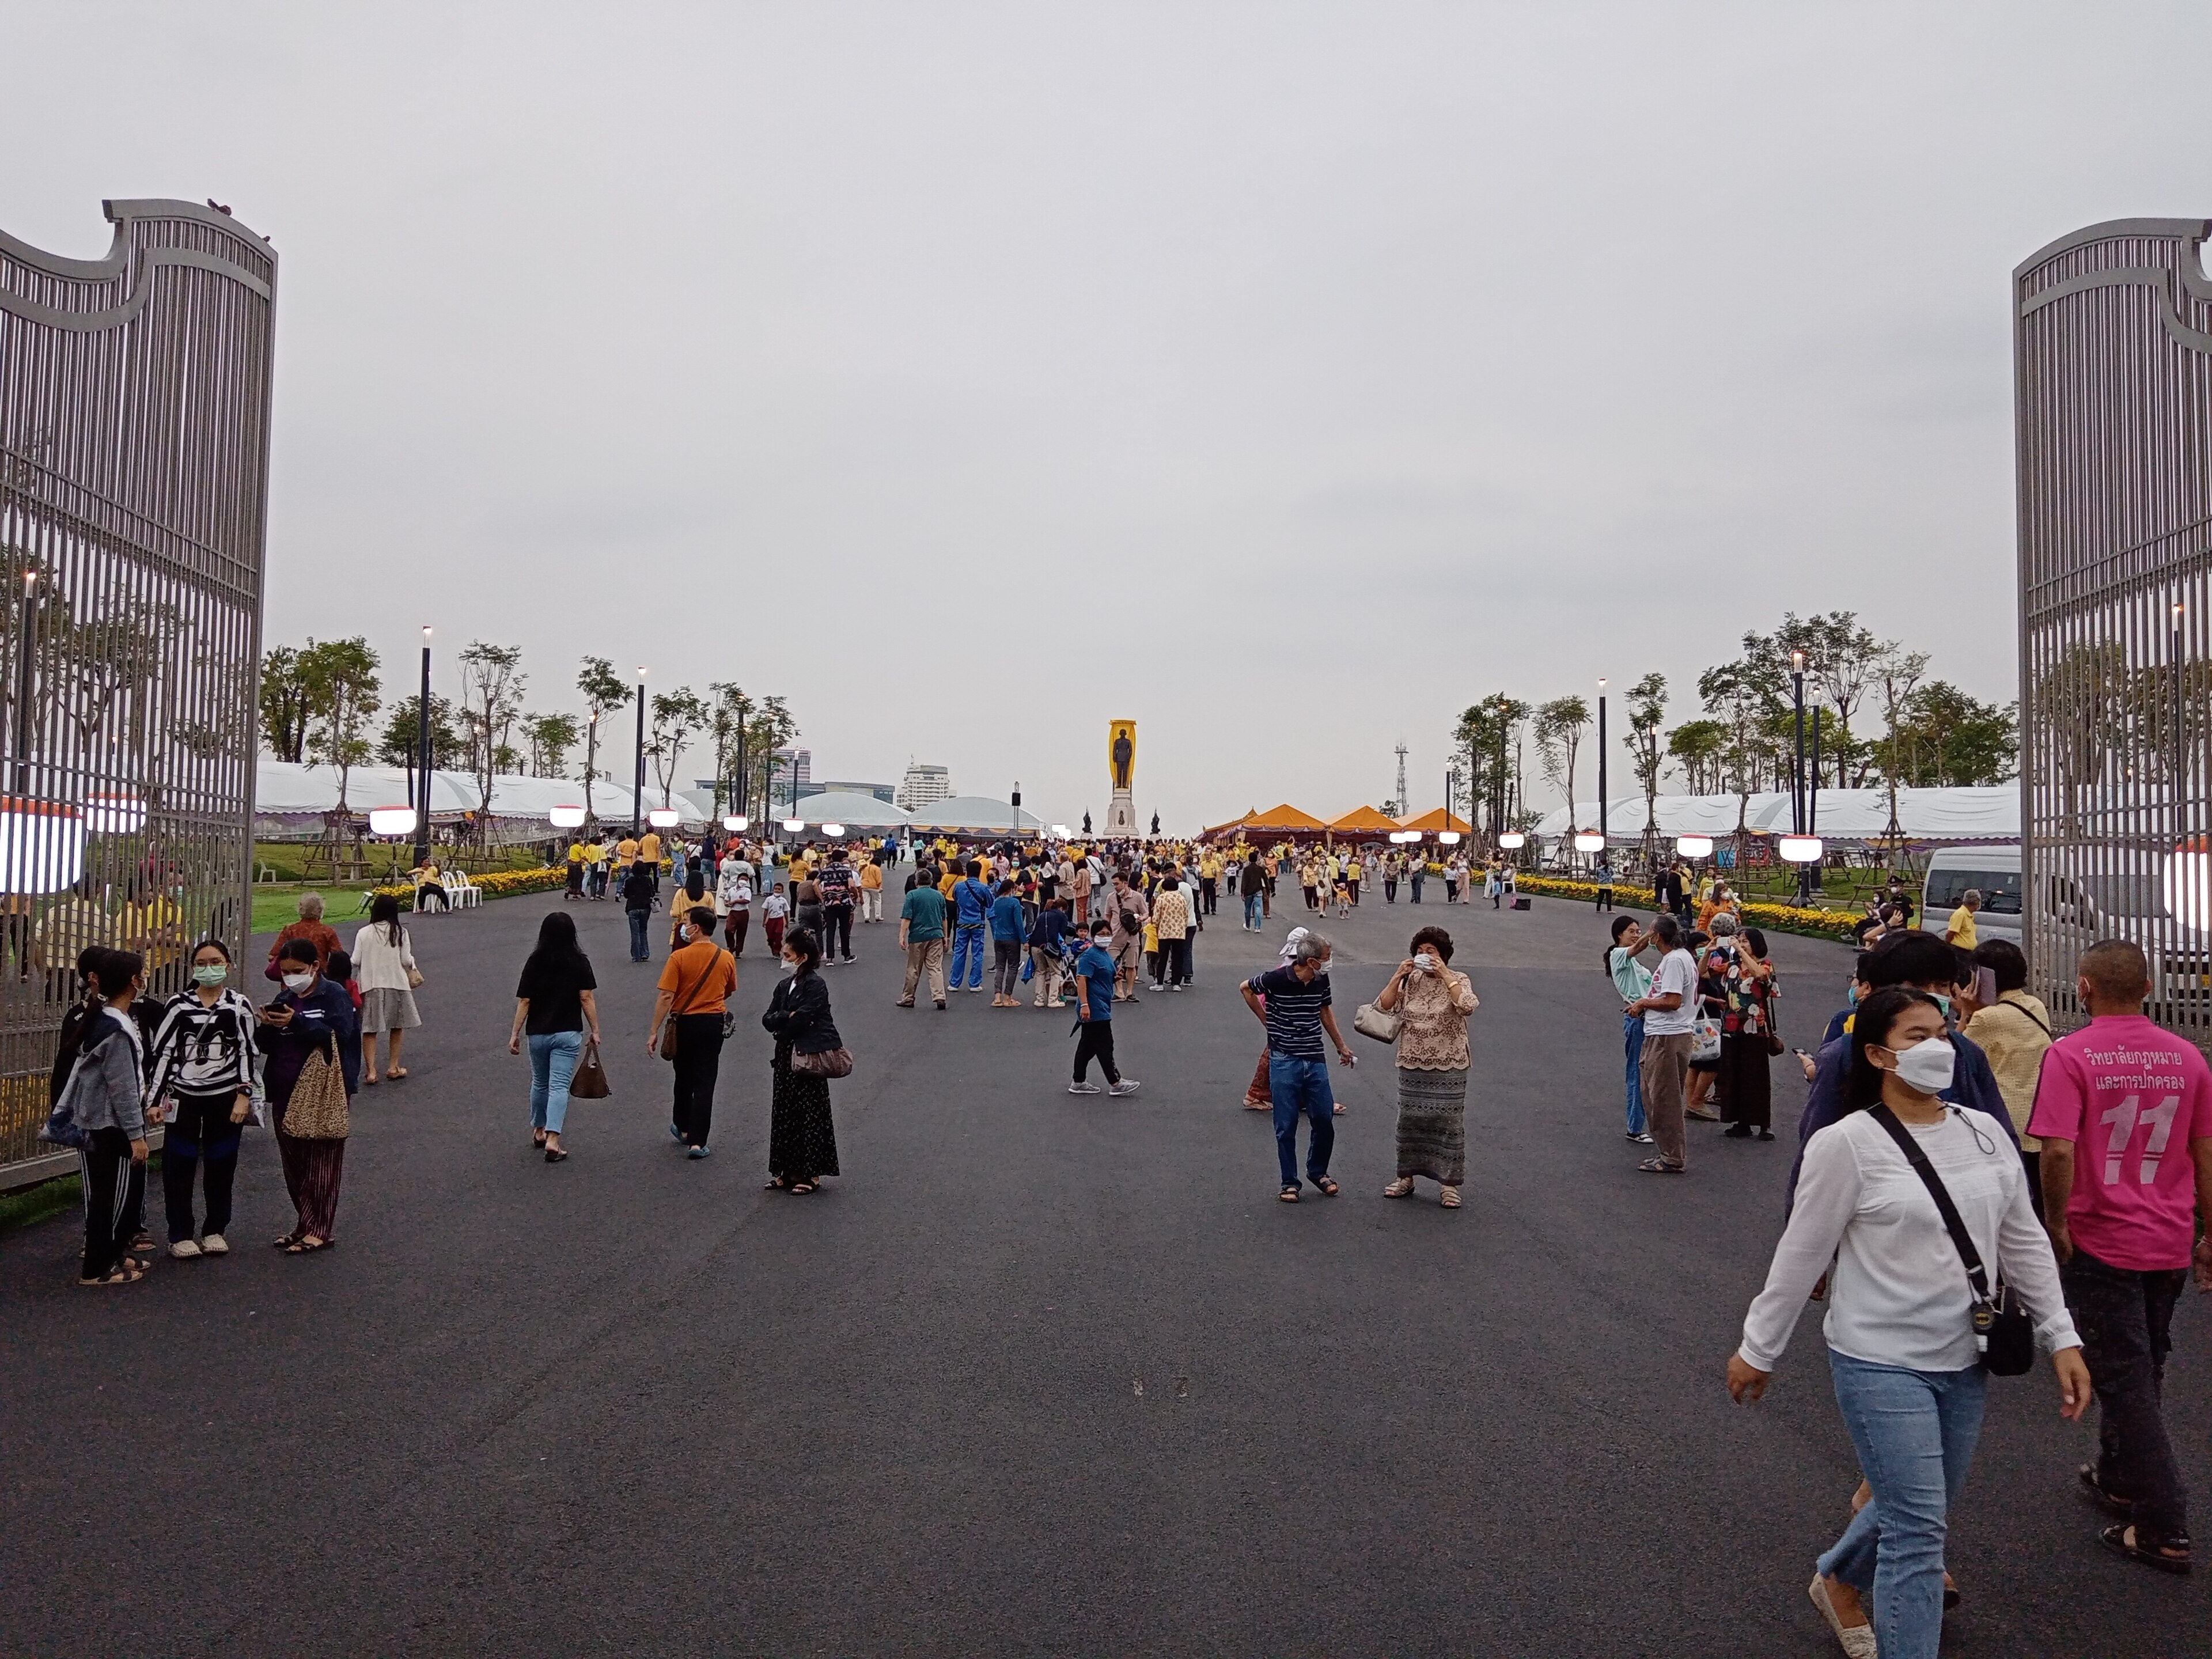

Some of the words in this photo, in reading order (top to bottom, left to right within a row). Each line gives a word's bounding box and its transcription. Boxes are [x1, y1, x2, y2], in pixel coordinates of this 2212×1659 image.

[2084, 1044, 2182, 1070] วิทยาลัยกฎหมาย
[2095, 1071, 2185, 1090] และการปกครอง
[2099, 1095, 2180, 1185] 11
